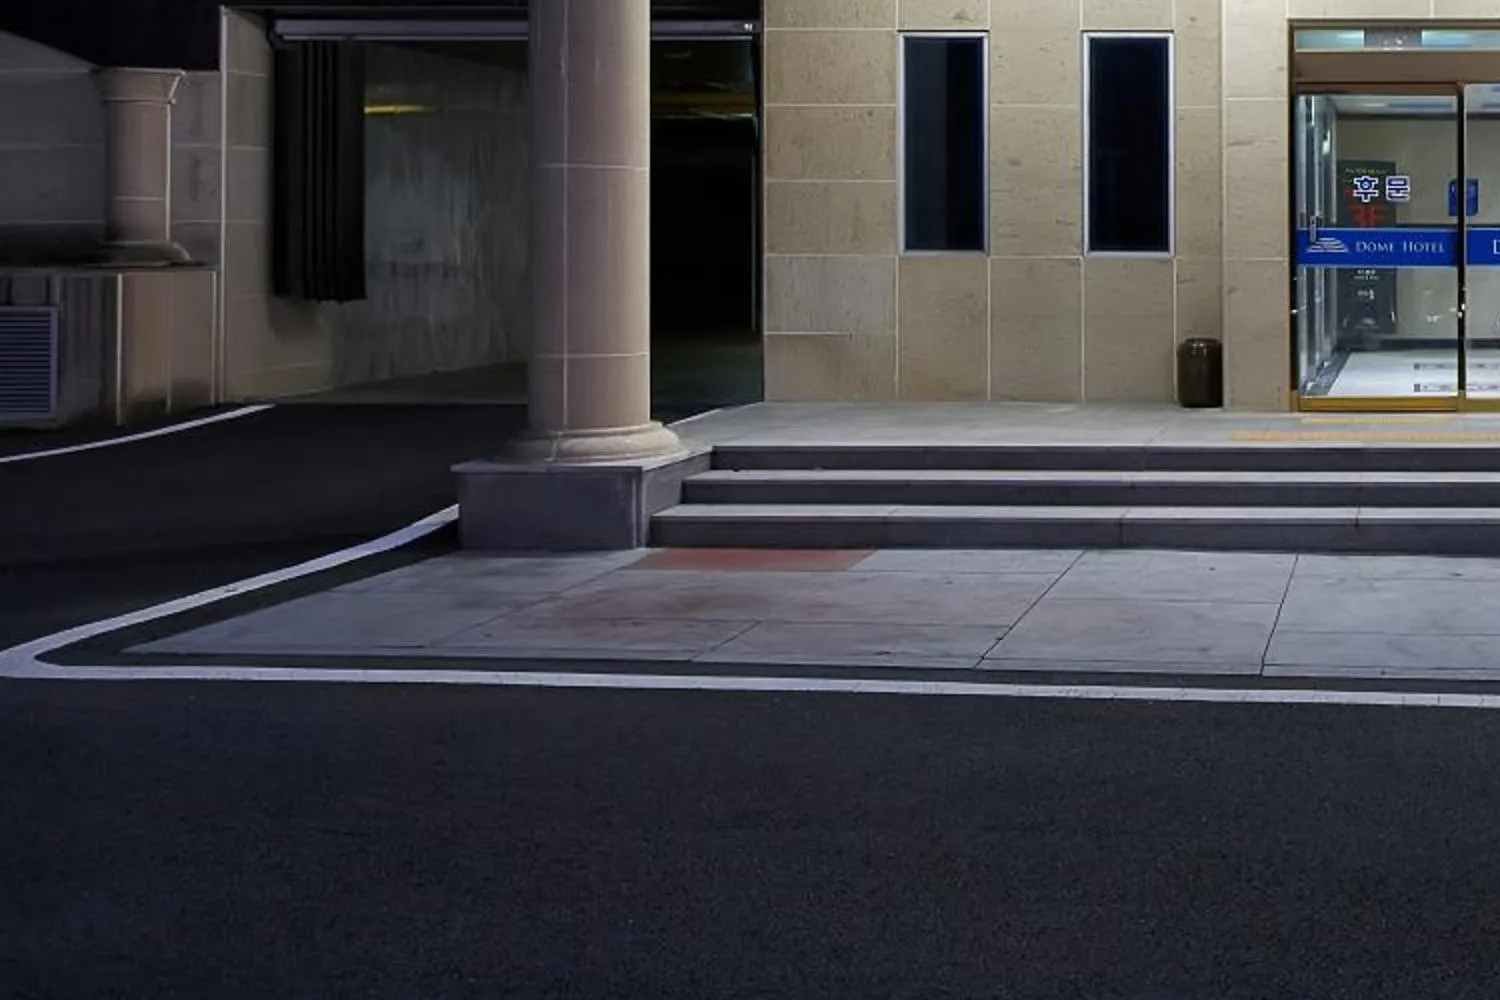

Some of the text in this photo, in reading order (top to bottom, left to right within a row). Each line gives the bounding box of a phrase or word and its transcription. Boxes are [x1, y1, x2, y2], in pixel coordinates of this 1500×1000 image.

[1353, 175, 1411, 203] 후문
[1355, 240, 1445, 253] DOME HOTEL
